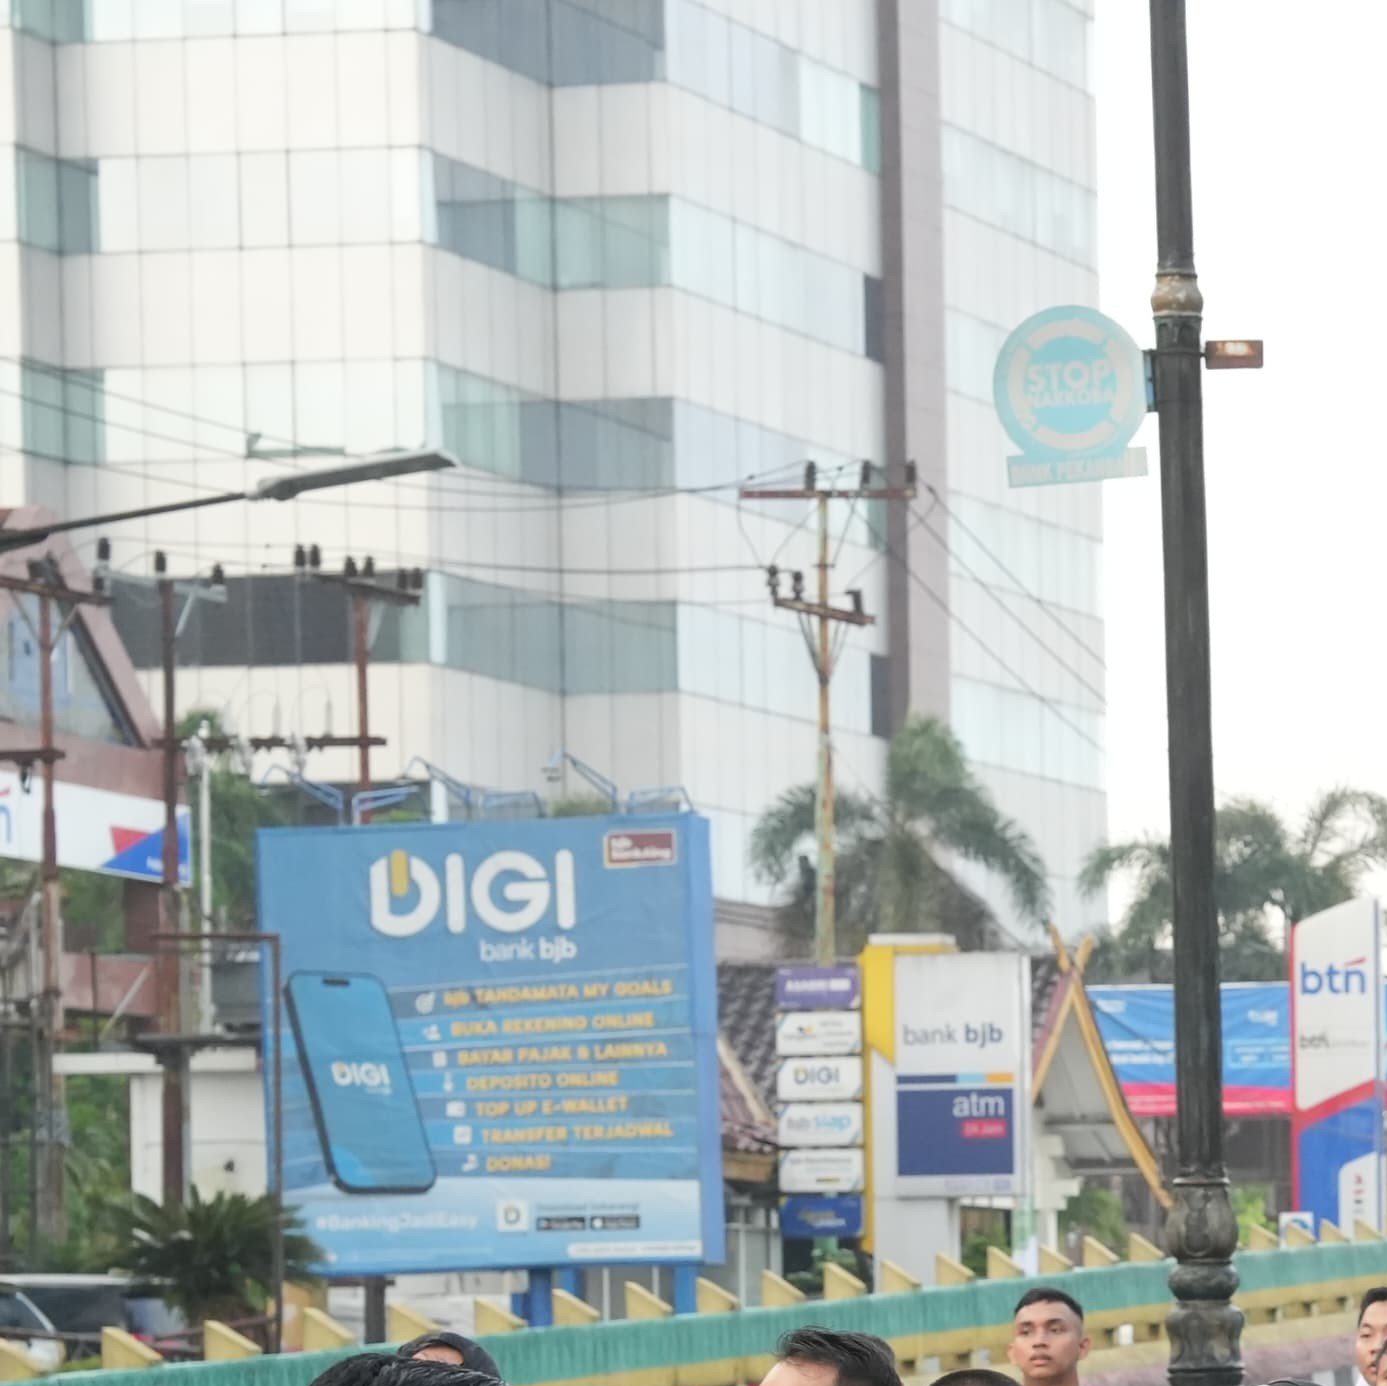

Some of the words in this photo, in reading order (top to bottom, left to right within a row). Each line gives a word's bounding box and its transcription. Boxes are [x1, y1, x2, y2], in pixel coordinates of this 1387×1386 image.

[1028, 359, 1113, 392] STOP
[370, 849, 576, 937] DIGI
[480, 940, 535, 962] bank
[540, 937, 577, 963] bjb
[1300, 958, 1366, 995] btn
[583, 982, 609, 999] MY
[452, 1020, 497, 1036] BUKA
[592, 1011, 655, 1029] ONLINE
[903, 1023, 958, 1046] bank
[965, 1023, 1004, 1048] bjb
[458, 1048, 513, 1066] BAYAR
[518, 1045, 573, 1063] PAJAK
[331, 1061, 391, 1086] DIGI
[467, 1073, 552, 1091] DEPOSITO
[556, 1070, 619, 1087] ONLINE
[476, 1101, 509, 1117] TOP
[514, 1100, 537, 1115] UP
[952, 1092, 1005, 1118] atm
[481, 1126, 567, 1144] TRANSFER
[486, 1155, 551, 1171] DONASI
